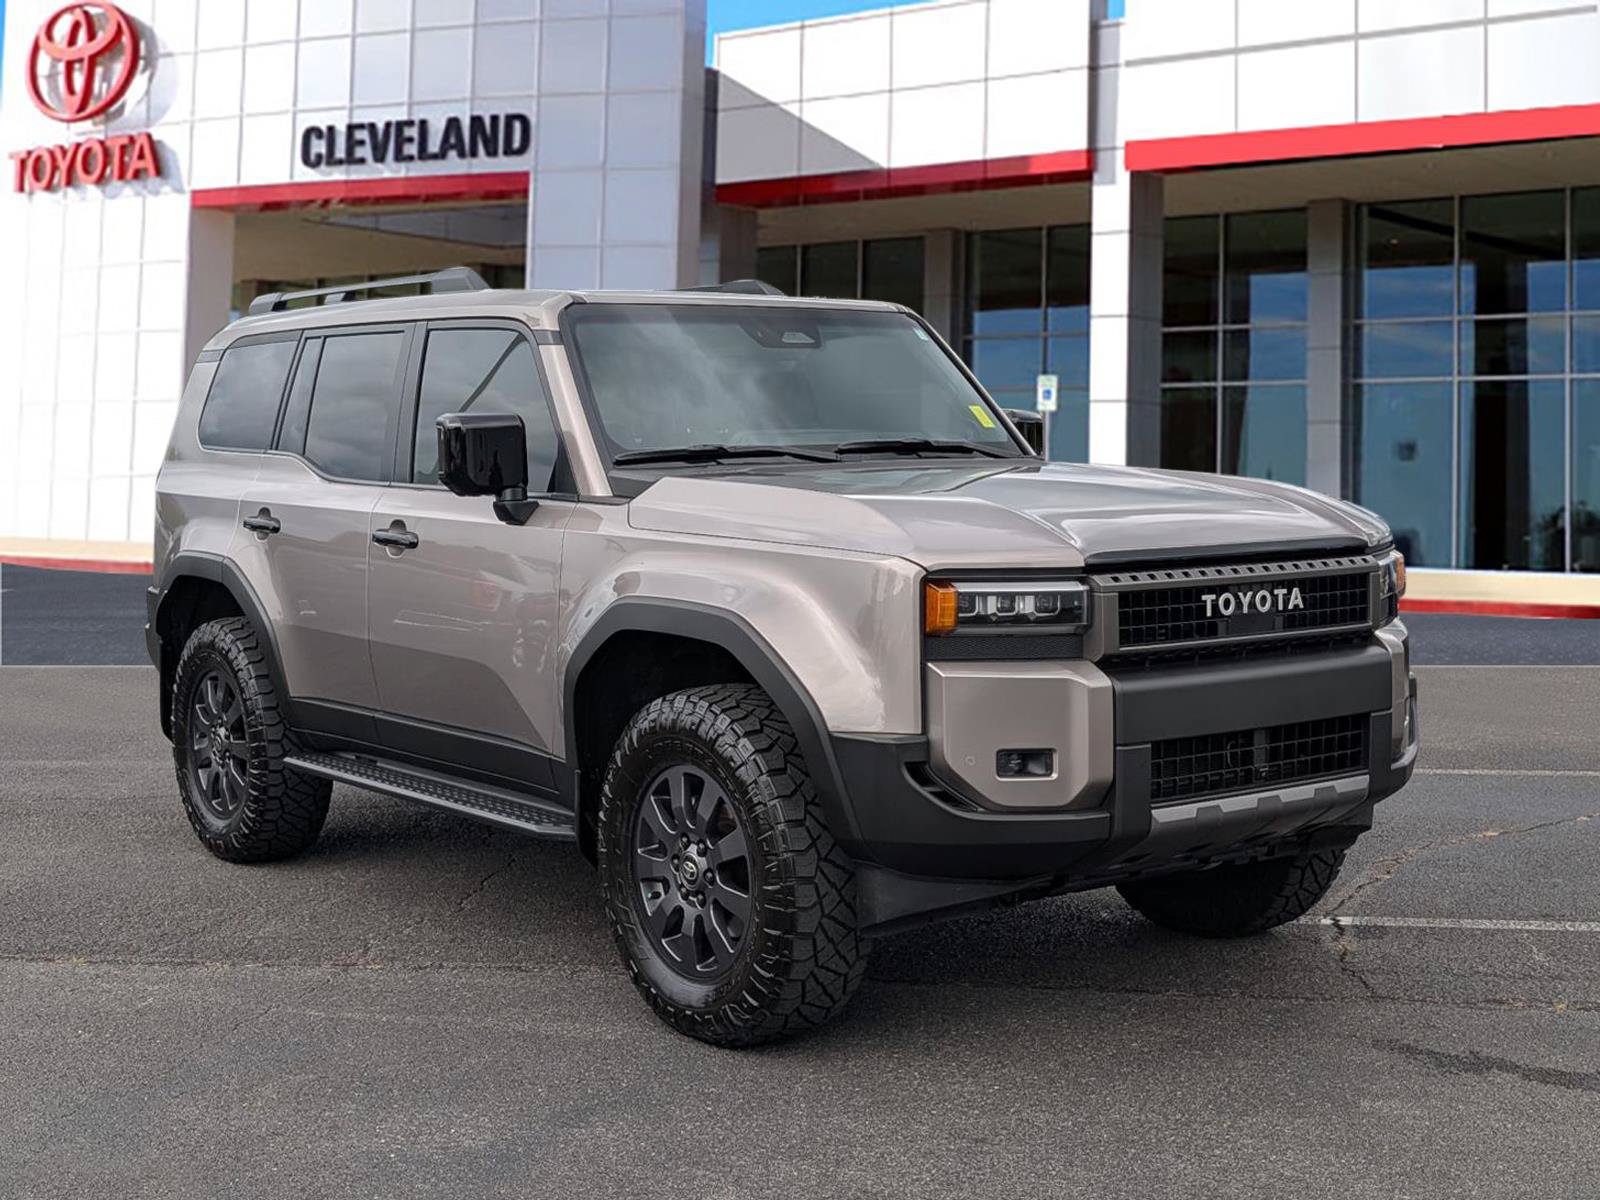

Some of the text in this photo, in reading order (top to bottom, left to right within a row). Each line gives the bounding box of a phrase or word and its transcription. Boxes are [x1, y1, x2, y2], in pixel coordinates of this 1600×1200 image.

[10, 132, 161, 193] TOYOTA
[302, 113, 532, 169] CLEVELAND
[1201, 587, 1304, 617] TOYOTA
